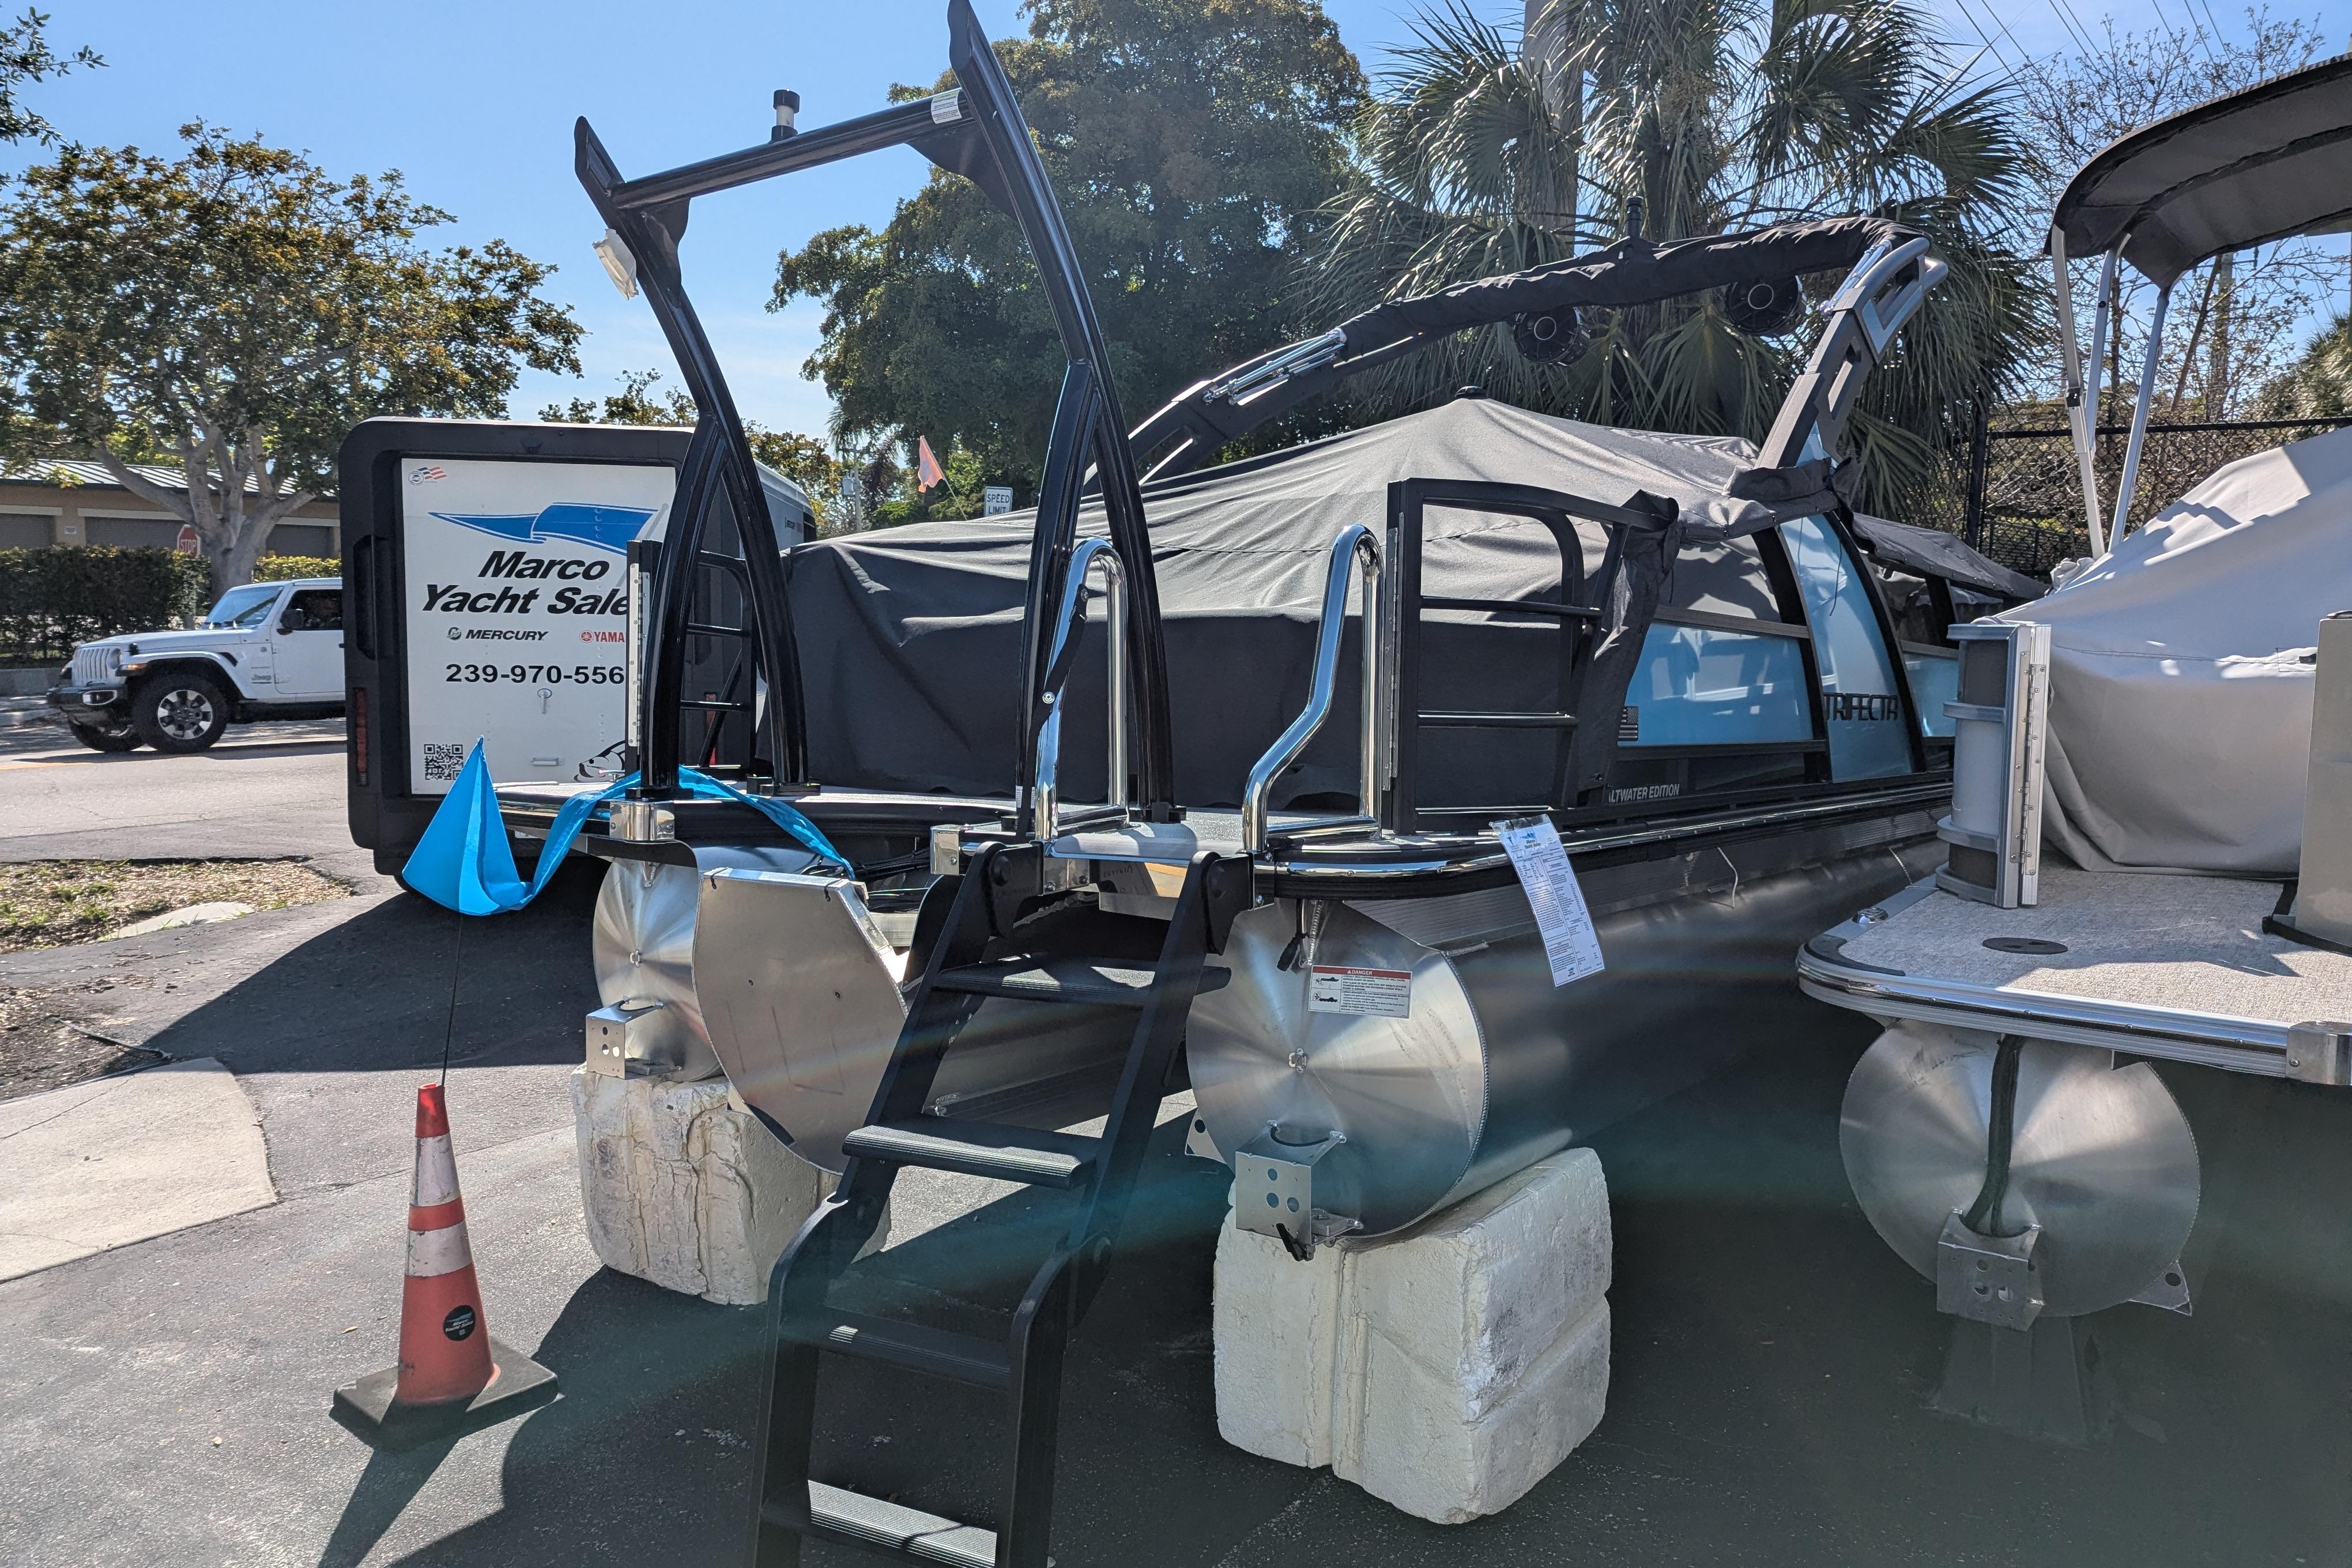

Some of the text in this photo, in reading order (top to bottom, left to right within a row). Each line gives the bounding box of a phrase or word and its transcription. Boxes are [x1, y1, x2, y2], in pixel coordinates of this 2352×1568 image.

[987, 493, 1010, 503] SPEED
[988, 506, 1007, 514] LIMIT
[180, 539, 197, 553] STOP
[477, 551, 610, 581] Marco
[422, 584, 627, 616] Yacht Sale
[465, 629, 549, 641] MERCURY
[594, 631, 625, 643] YAMA
[445, 664, 625, 684] 239-970-556
[1822, 692, 1898, 721] TRIFECTA
[1608, 784, 1680, 803] LTWATER EDITION
